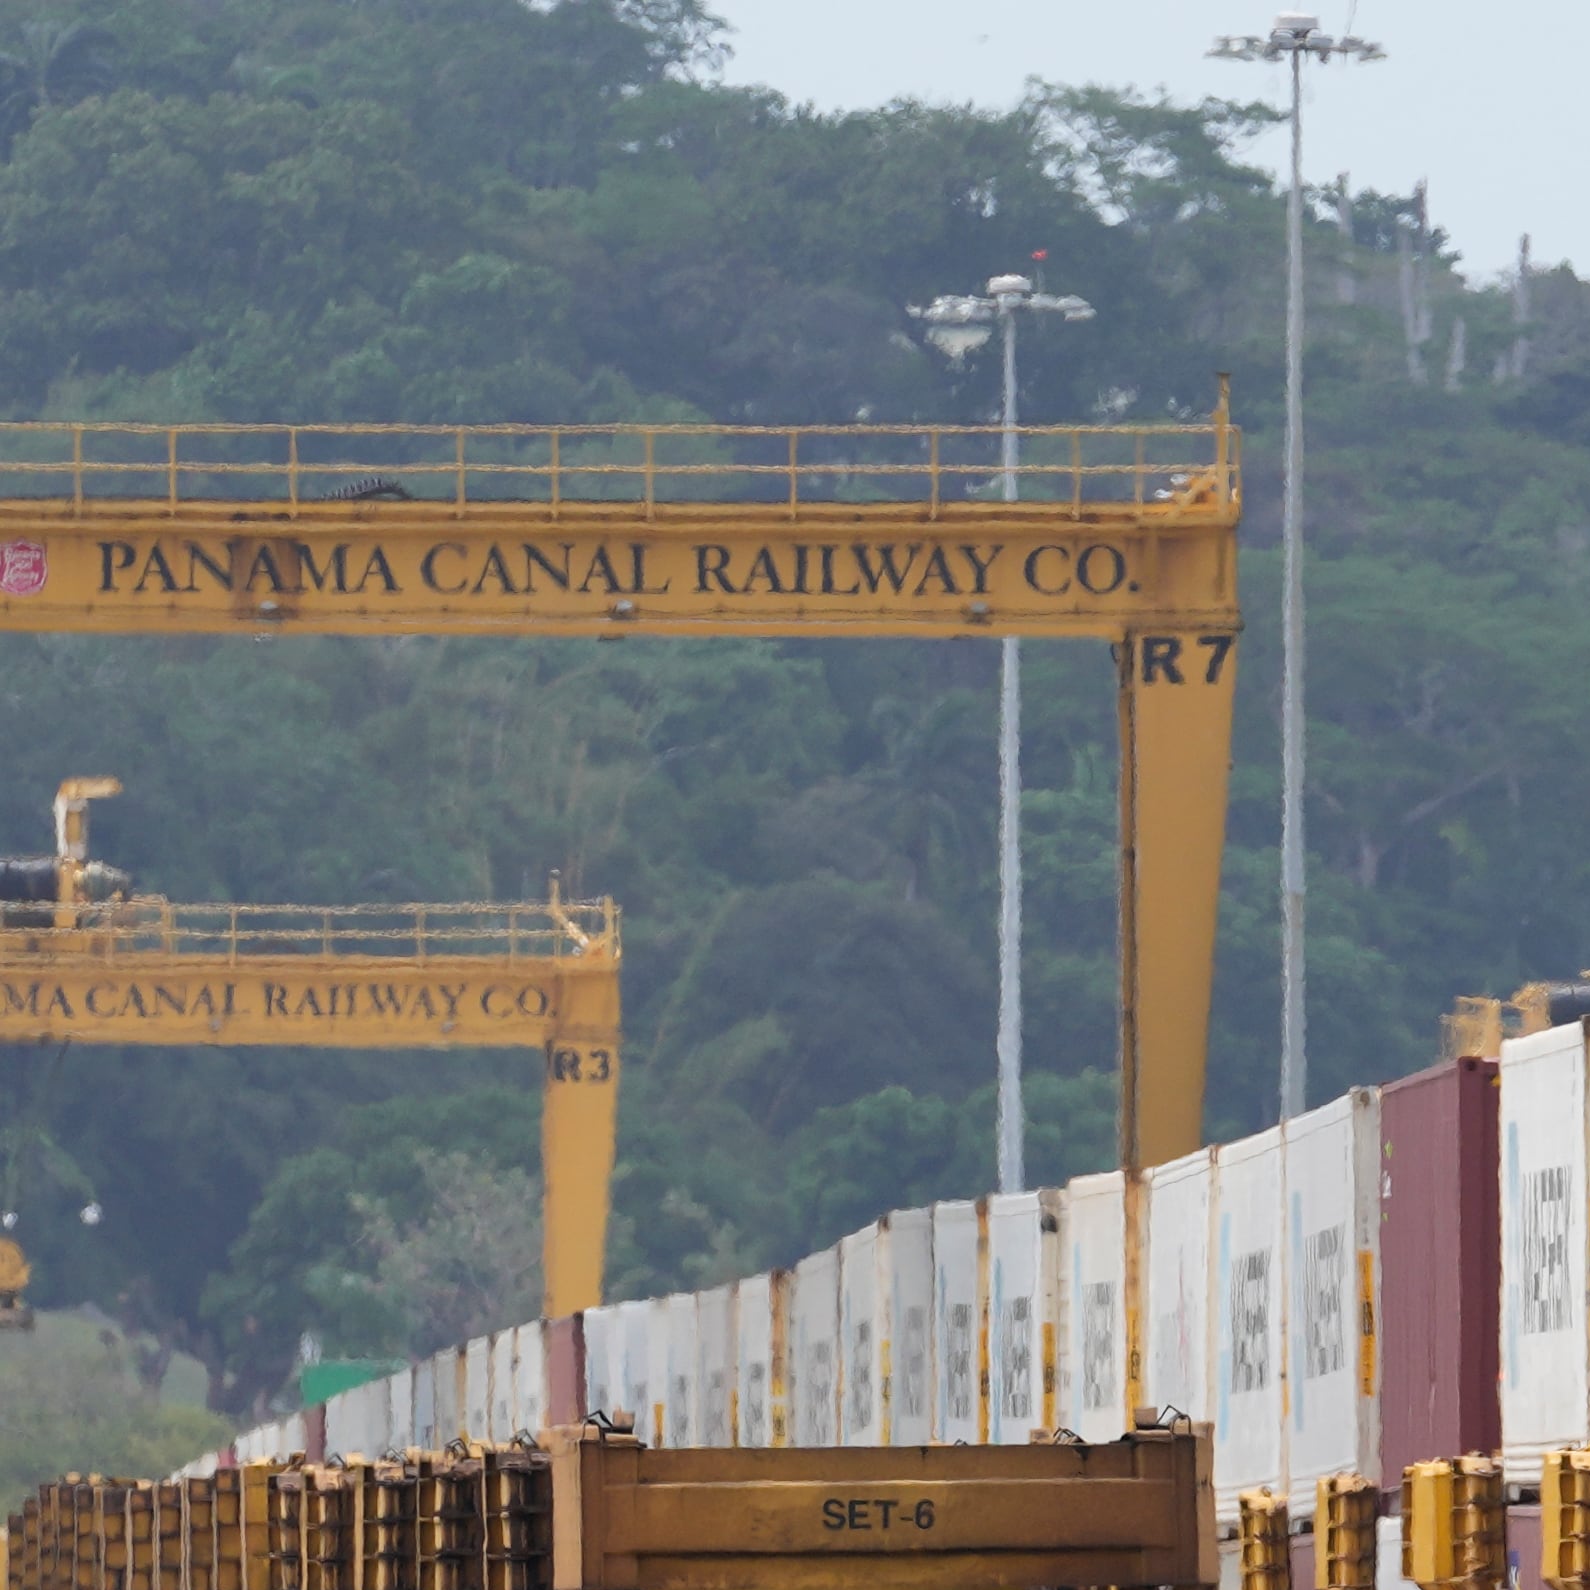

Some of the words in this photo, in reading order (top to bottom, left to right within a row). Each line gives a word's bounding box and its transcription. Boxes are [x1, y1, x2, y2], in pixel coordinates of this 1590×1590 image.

[98, 540, 402, 594] PANAMA
[420, 541, 671, 594] CANAL
[691, 543, 1004, 596] RAILWAY
[1023, 543, 1141, 595] CO.
[85, 980, 249, 1018] CANAL
[263, 982, 466, 1019] RAILWAY
[480, 983, 557, 1018] CO.
[822, 1498, 935, 1532] SET-6
